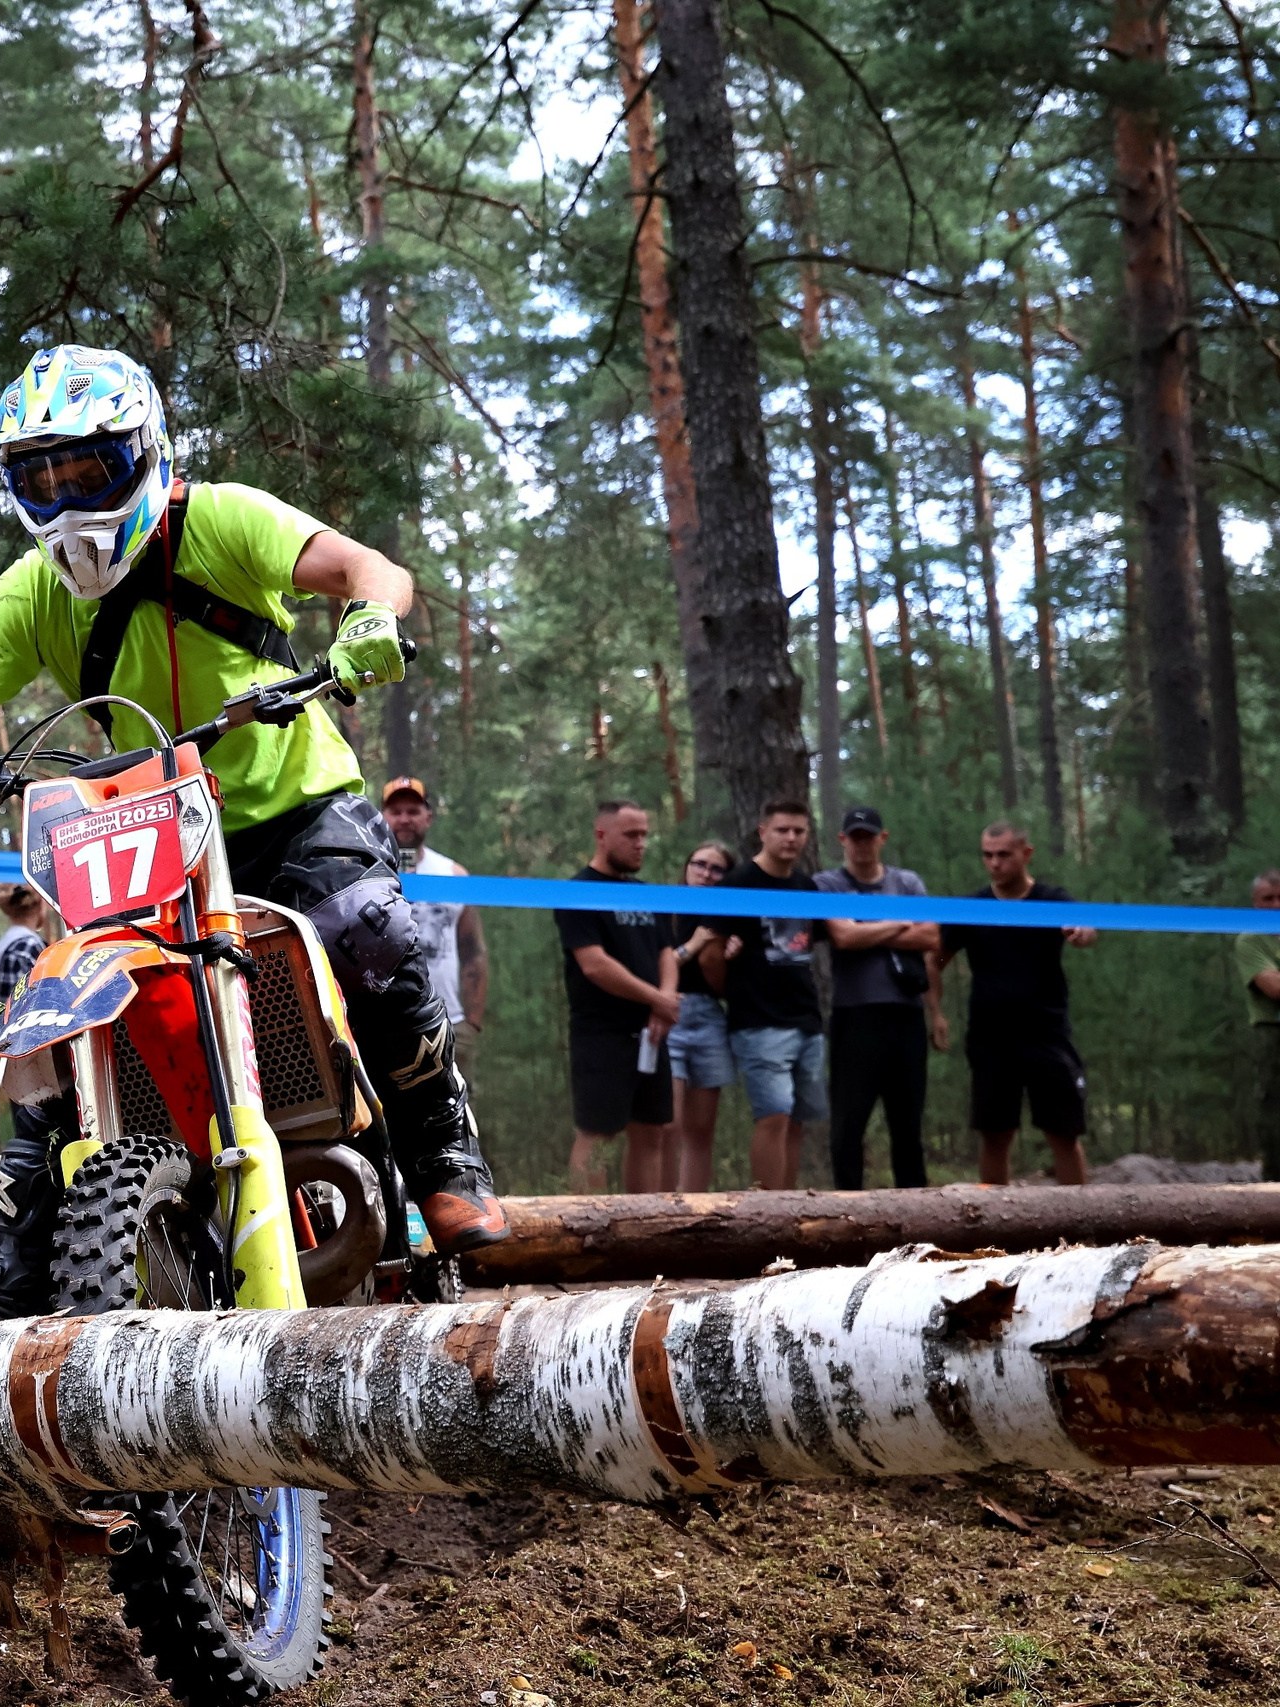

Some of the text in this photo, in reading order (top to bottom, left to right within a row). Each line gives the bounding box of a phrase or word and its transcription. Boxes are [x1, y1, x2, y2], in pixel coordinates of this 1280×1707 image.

[32, 790, 73, 813] KTM
[58, 813, 116, 838] ВНЕ ЗОНЫ
[121, 801, 170, 827] 2025
[59, 823, 118, 847] КОМФОРТА
[30, 844, 53, 861] READY
[32, 861, 52, 875] RACE
[72, 827, 159, 909] 17
